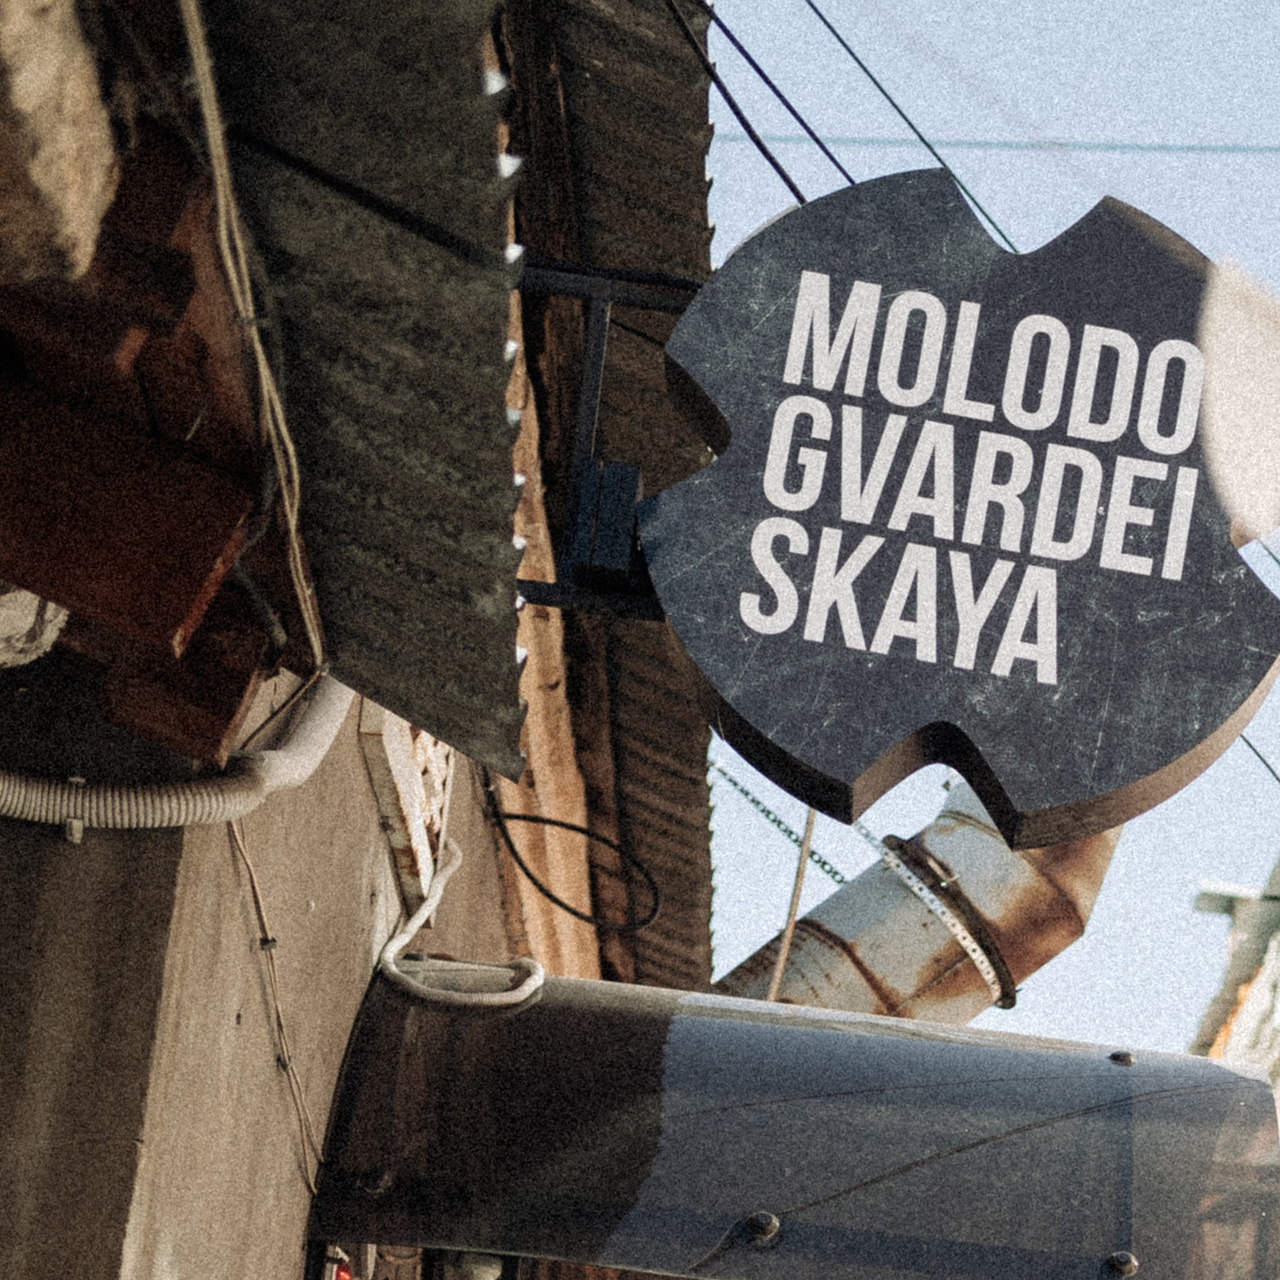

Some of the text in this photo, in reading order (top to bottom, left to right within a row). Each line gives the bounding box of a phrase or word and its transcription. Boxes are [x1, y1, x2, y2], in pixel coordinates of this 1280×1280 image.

[782, 270, 1205, 455] MOLODO
[763, 395, 1198, 581] GVARDEI
[739, 517, 1058, 684] SKAYA
